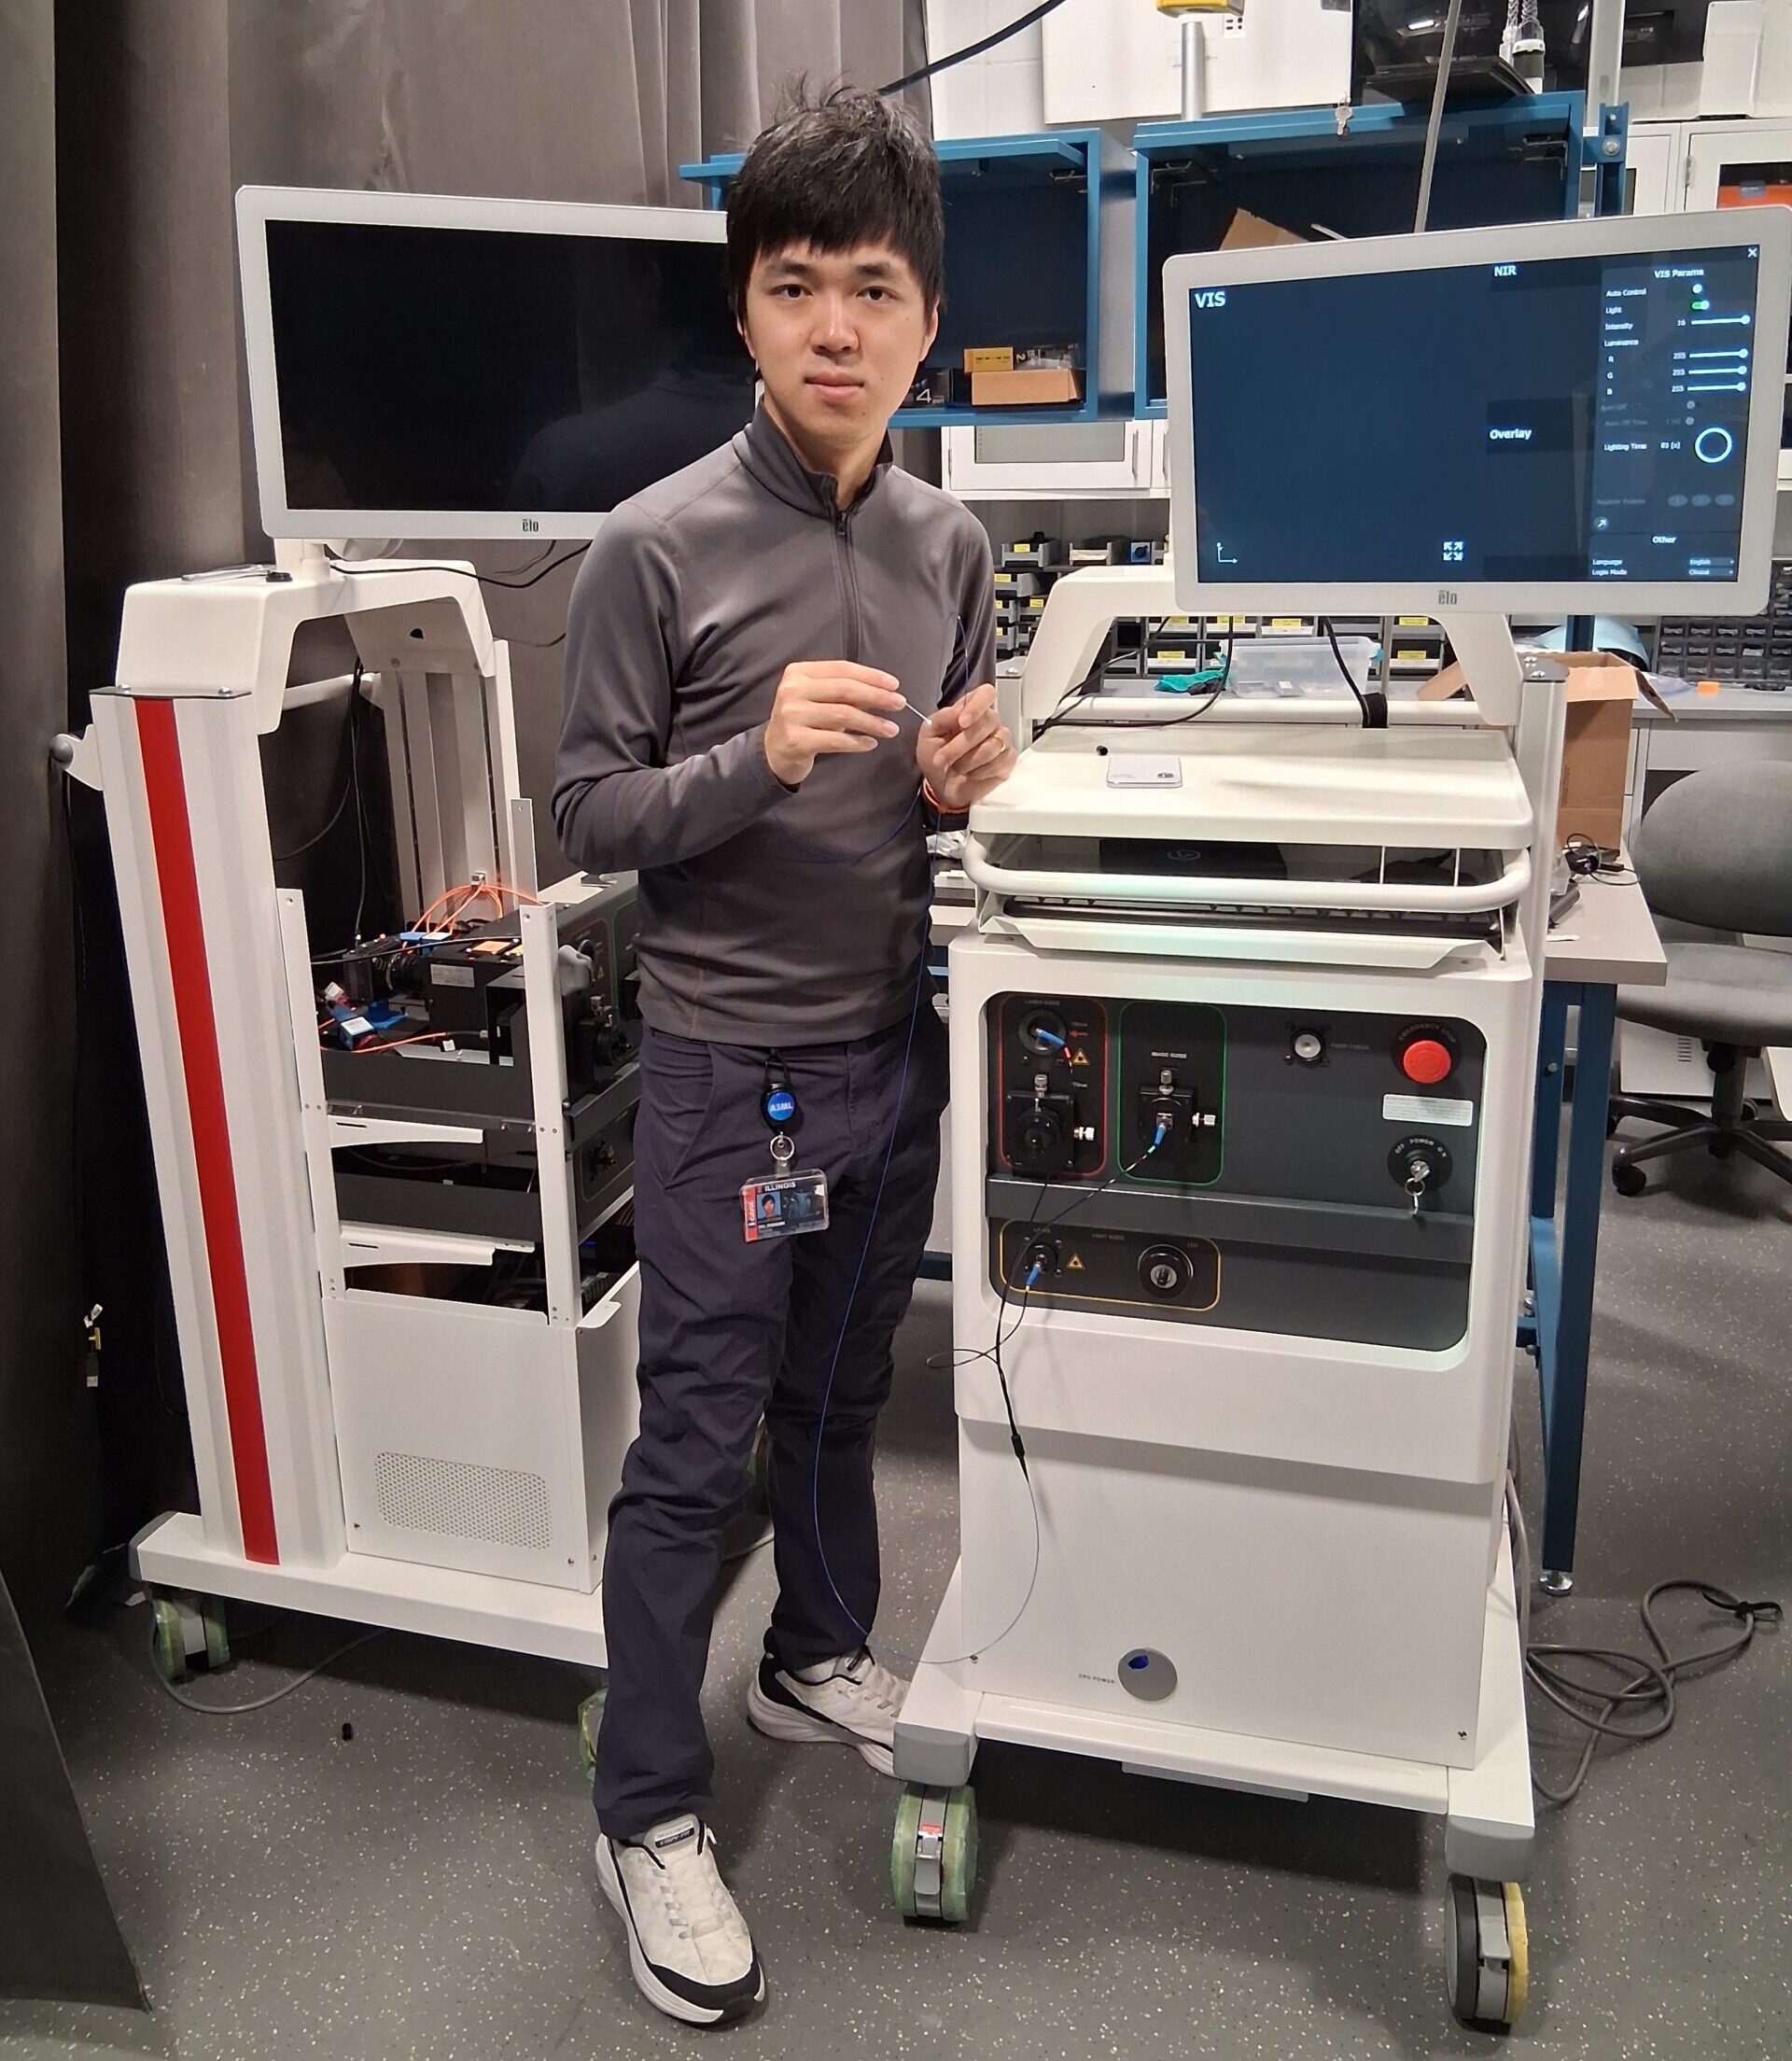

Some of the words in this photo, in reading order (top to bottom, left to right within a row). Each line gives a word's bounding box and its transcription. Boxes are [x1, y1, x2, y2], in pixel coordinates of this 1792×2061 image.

[1493, 265, 1517, 277] NIR
[1654, 269, 1671, 278] VIS
[1672, 268, 1704, 277] Params
[1605, 288, 1622, 297] Auto
[1622, 287, 1646, 296] Control
[1195, 291, 1226, 308] VIS
[1605, 305, 1622, 315] Light
[916, 388, 931, 403] 4
[1489, 428, 1533, 441] Overlay
[1652, 535, 1677, 544] Other
[1409, 1138, 1435, 1146] POWER
[765, 1181, 796, 1192] ILLINOIS
